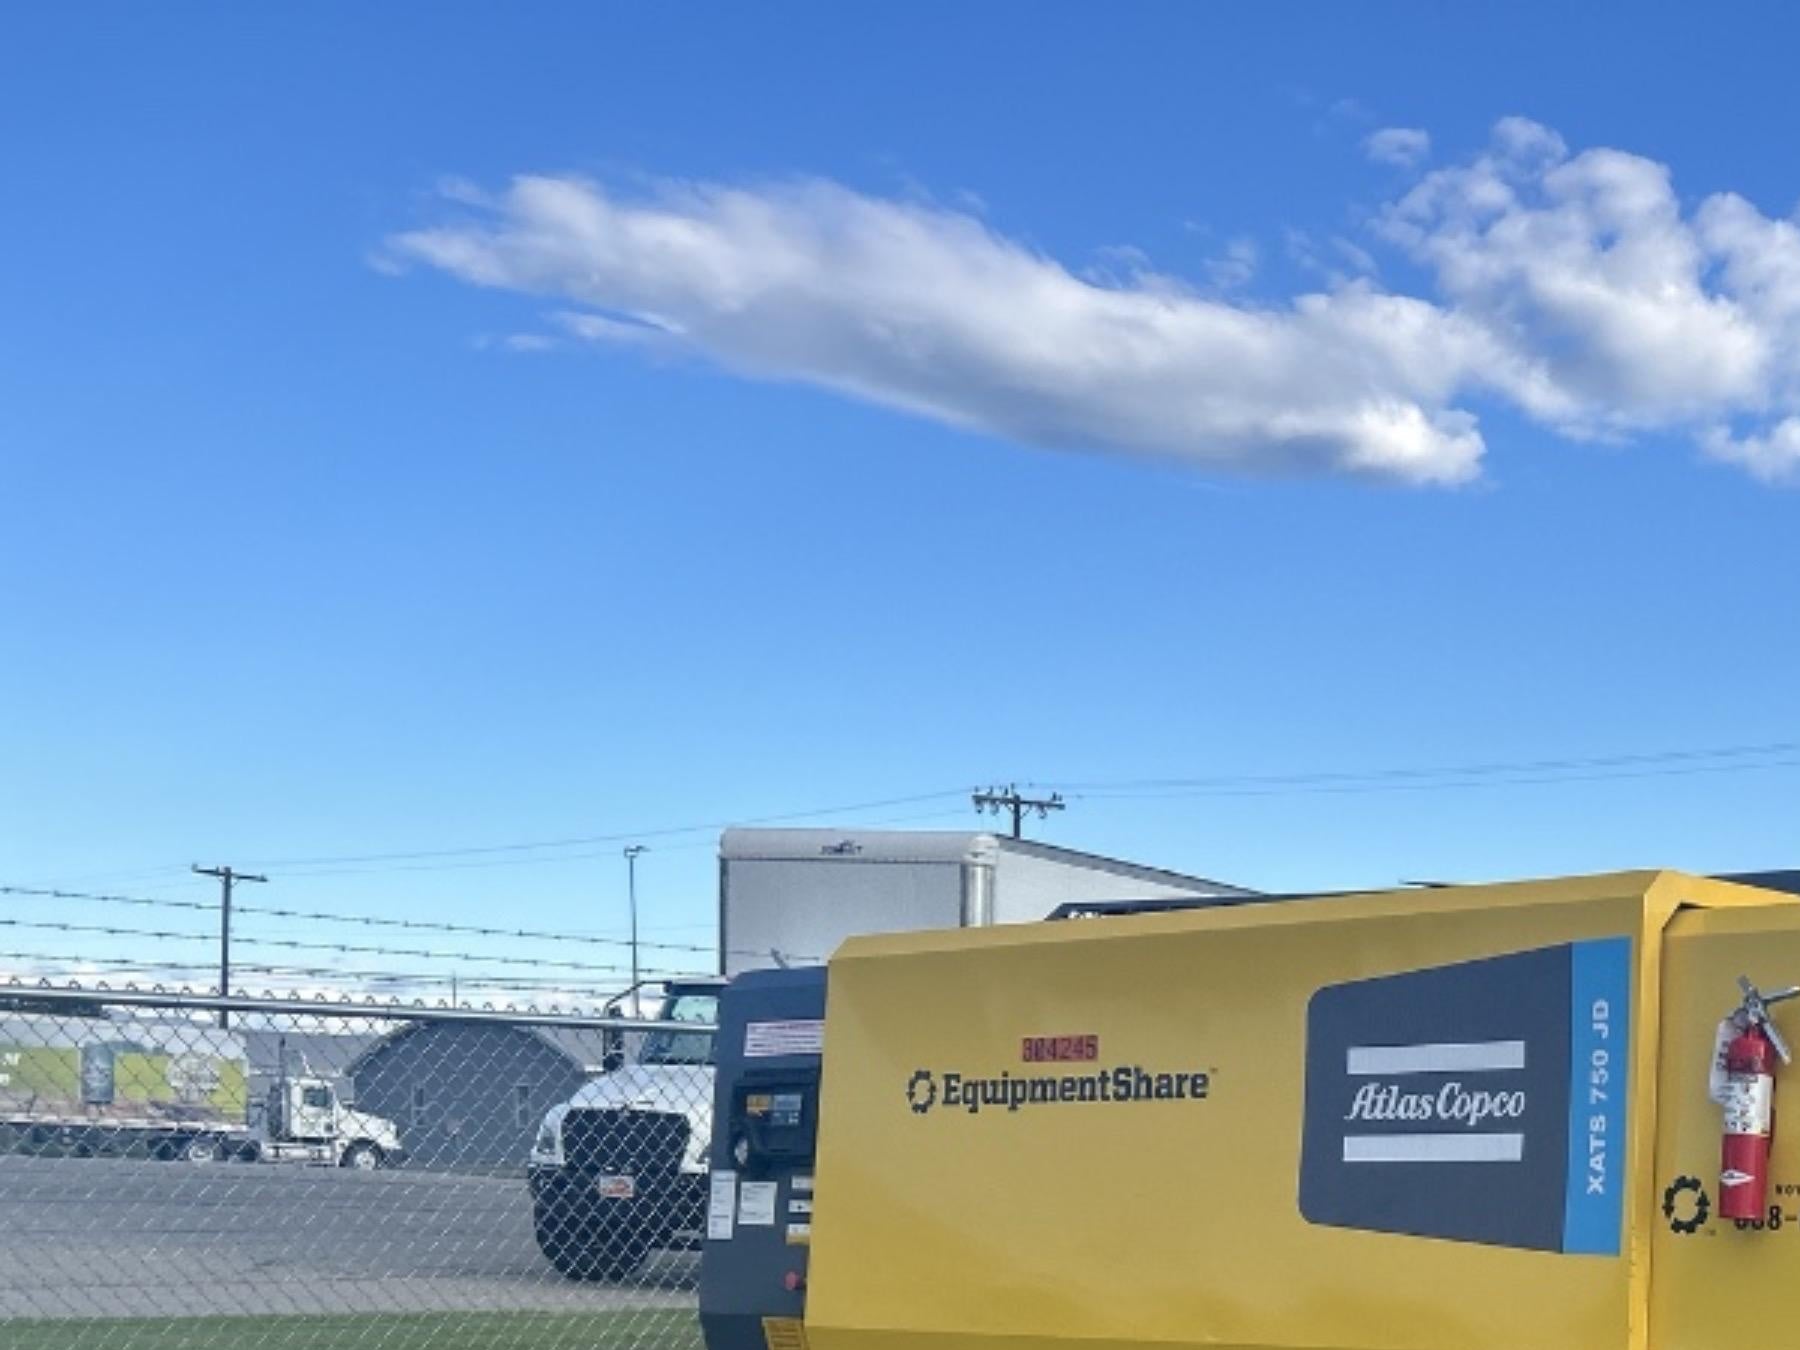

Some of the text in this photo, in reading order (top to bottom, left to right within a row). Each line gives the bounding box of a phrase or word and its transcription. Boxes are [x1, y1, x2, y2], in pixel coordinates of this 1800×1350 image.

[941, 1066, 1210, 1114] EquipmentShare
[1344, 1081, 1526, 1126] Atlas Copco
[1586, 998, 1610, 1196] XATS 750 JD
